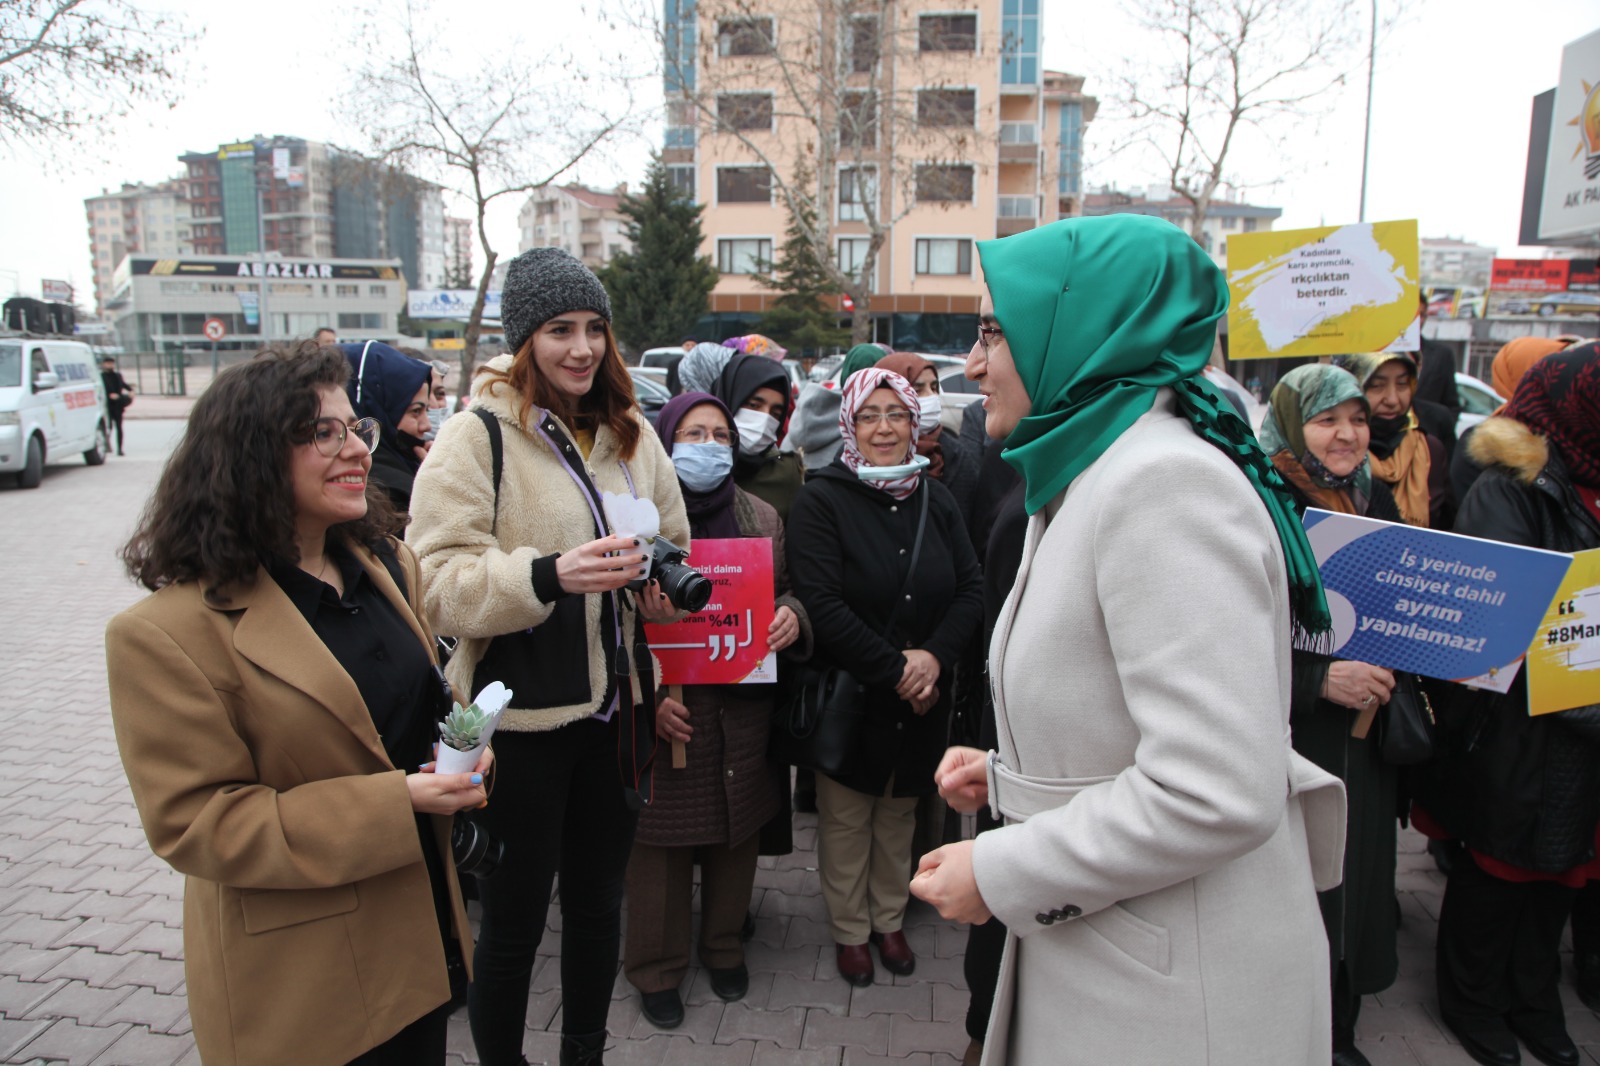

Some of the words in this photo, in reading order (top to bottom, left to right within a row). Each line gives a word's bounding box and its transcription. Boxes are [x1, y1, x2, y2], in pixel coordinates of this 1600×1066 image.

[1563, 191, 1580, 208] AK
[1583, 186, 1600, 206] PA
[237, 262, 333, 279] ABAZLAR
[1291, 272, 1350, 284] ırkçılıktan
[1297, 286, 1348, 298] beterdir.
[690, 565, 712, 574] mizi
[713, 565, 742, 573] daima
[1400, 547, 1417, 567] İş
[1420, 556, 1497, 582] yerinde
[710, 579, 732, 587] oruz,
[1375, 569, 1451, 595] cinsiyet
[1454, 585, 1506, 606] dahil
[1394, 598, 1463, 623] ayrım
[708, 614, 739, 627] %41
[1358, 616, 1487, 653] yapılamaz!
